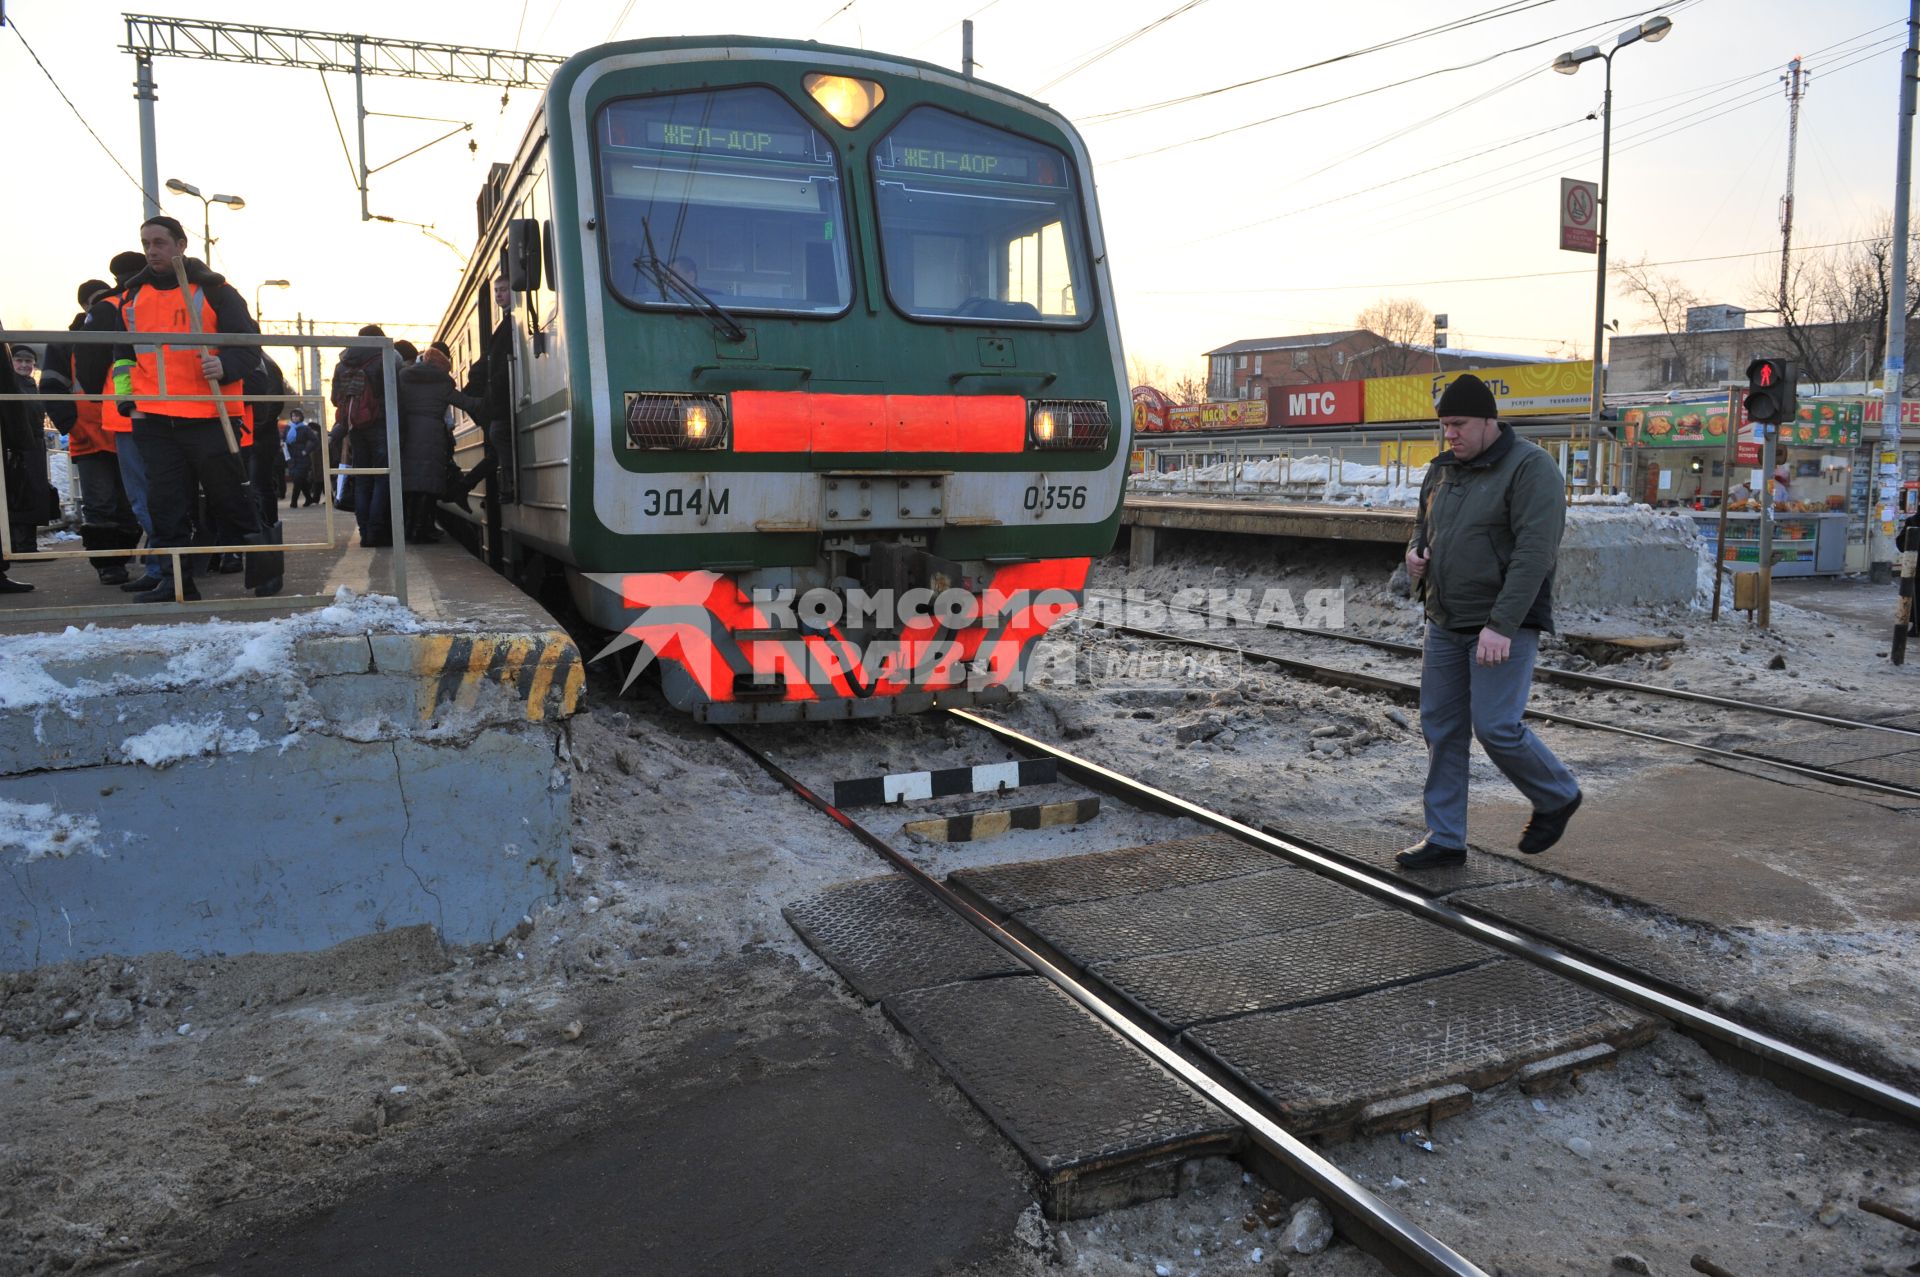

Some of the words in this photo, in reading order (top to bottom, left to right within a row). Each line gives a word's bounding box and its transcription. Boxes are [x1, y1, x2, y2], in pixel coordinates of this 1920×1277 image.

[1202, 409, 1224, 422] МЯСО
[1289, 391, 1336, 416] МТС
[644, 488, 729, 516] ЭД4М
[1023, 485, 1087, 510] 0356
